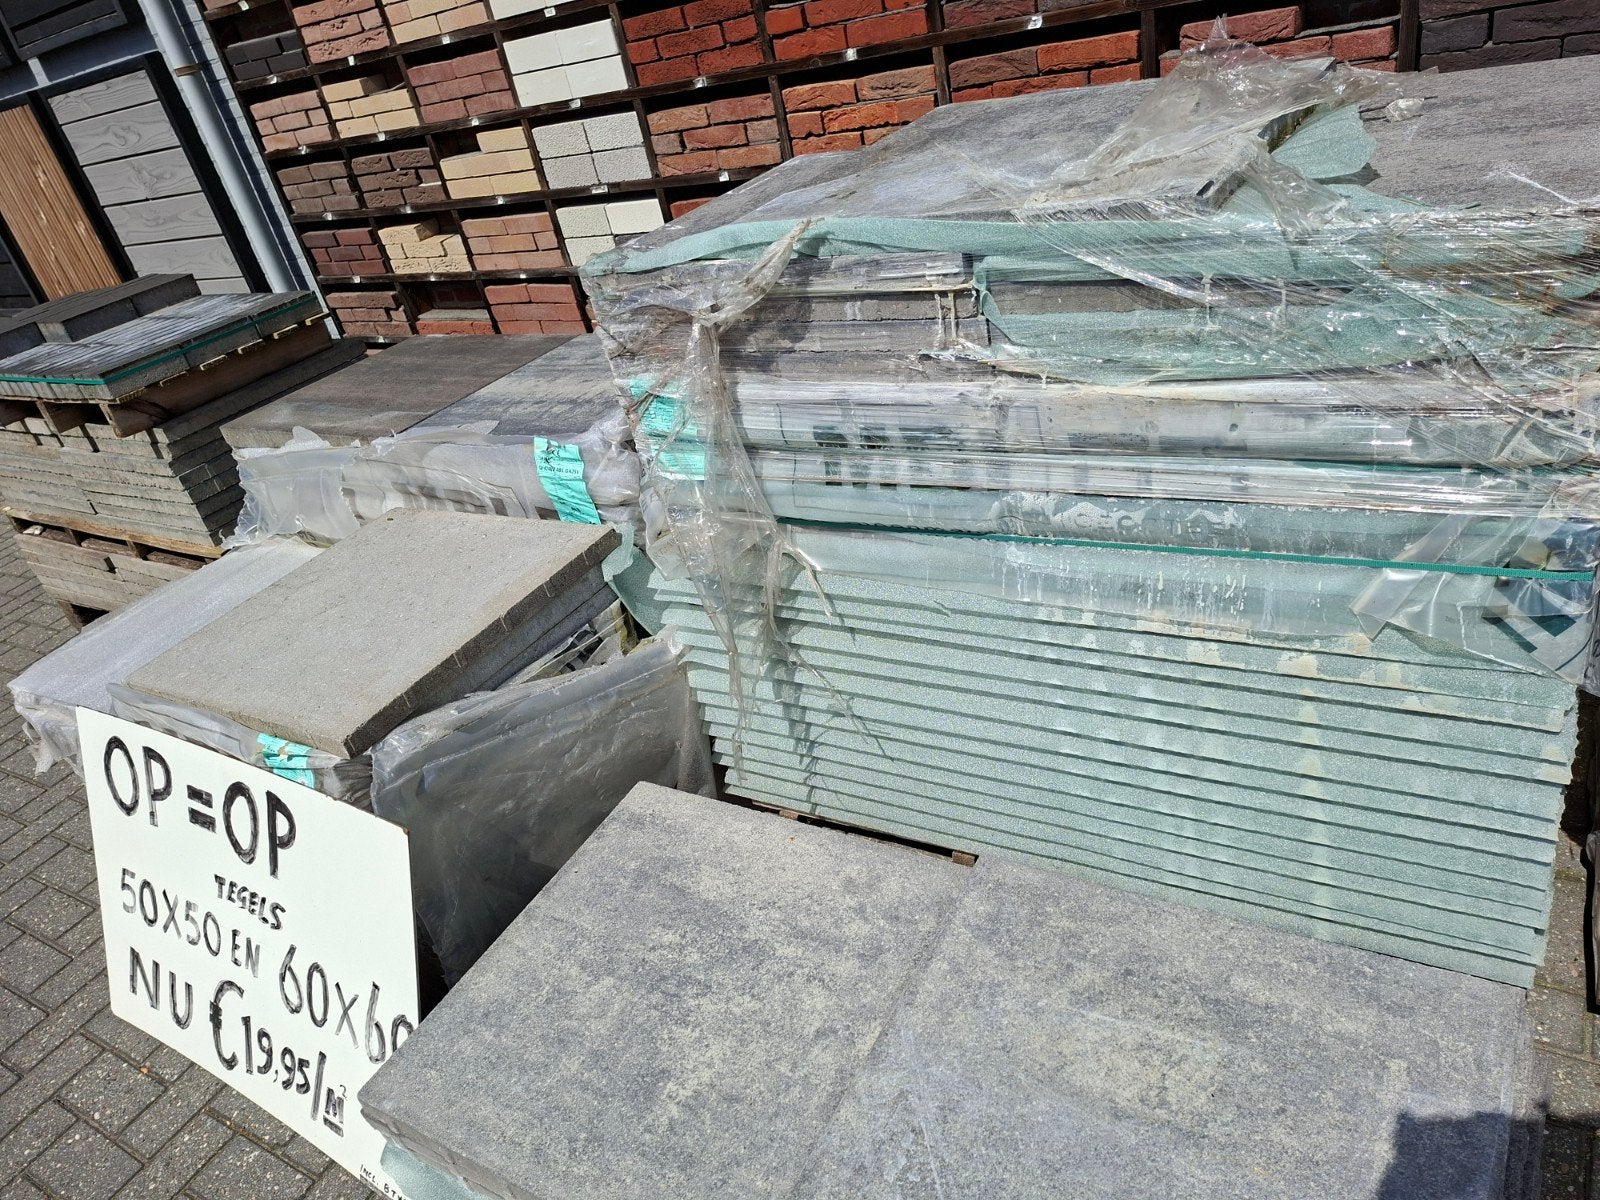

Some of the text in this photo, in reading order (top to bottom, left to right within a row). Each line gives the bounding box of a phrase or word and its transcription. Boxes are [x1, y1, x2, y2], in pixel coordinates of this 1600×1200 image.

[213, 873, 286, 931] TEGELS
[231, 928, 261, 979] EN
[129, 946, 193, 1031] NU
